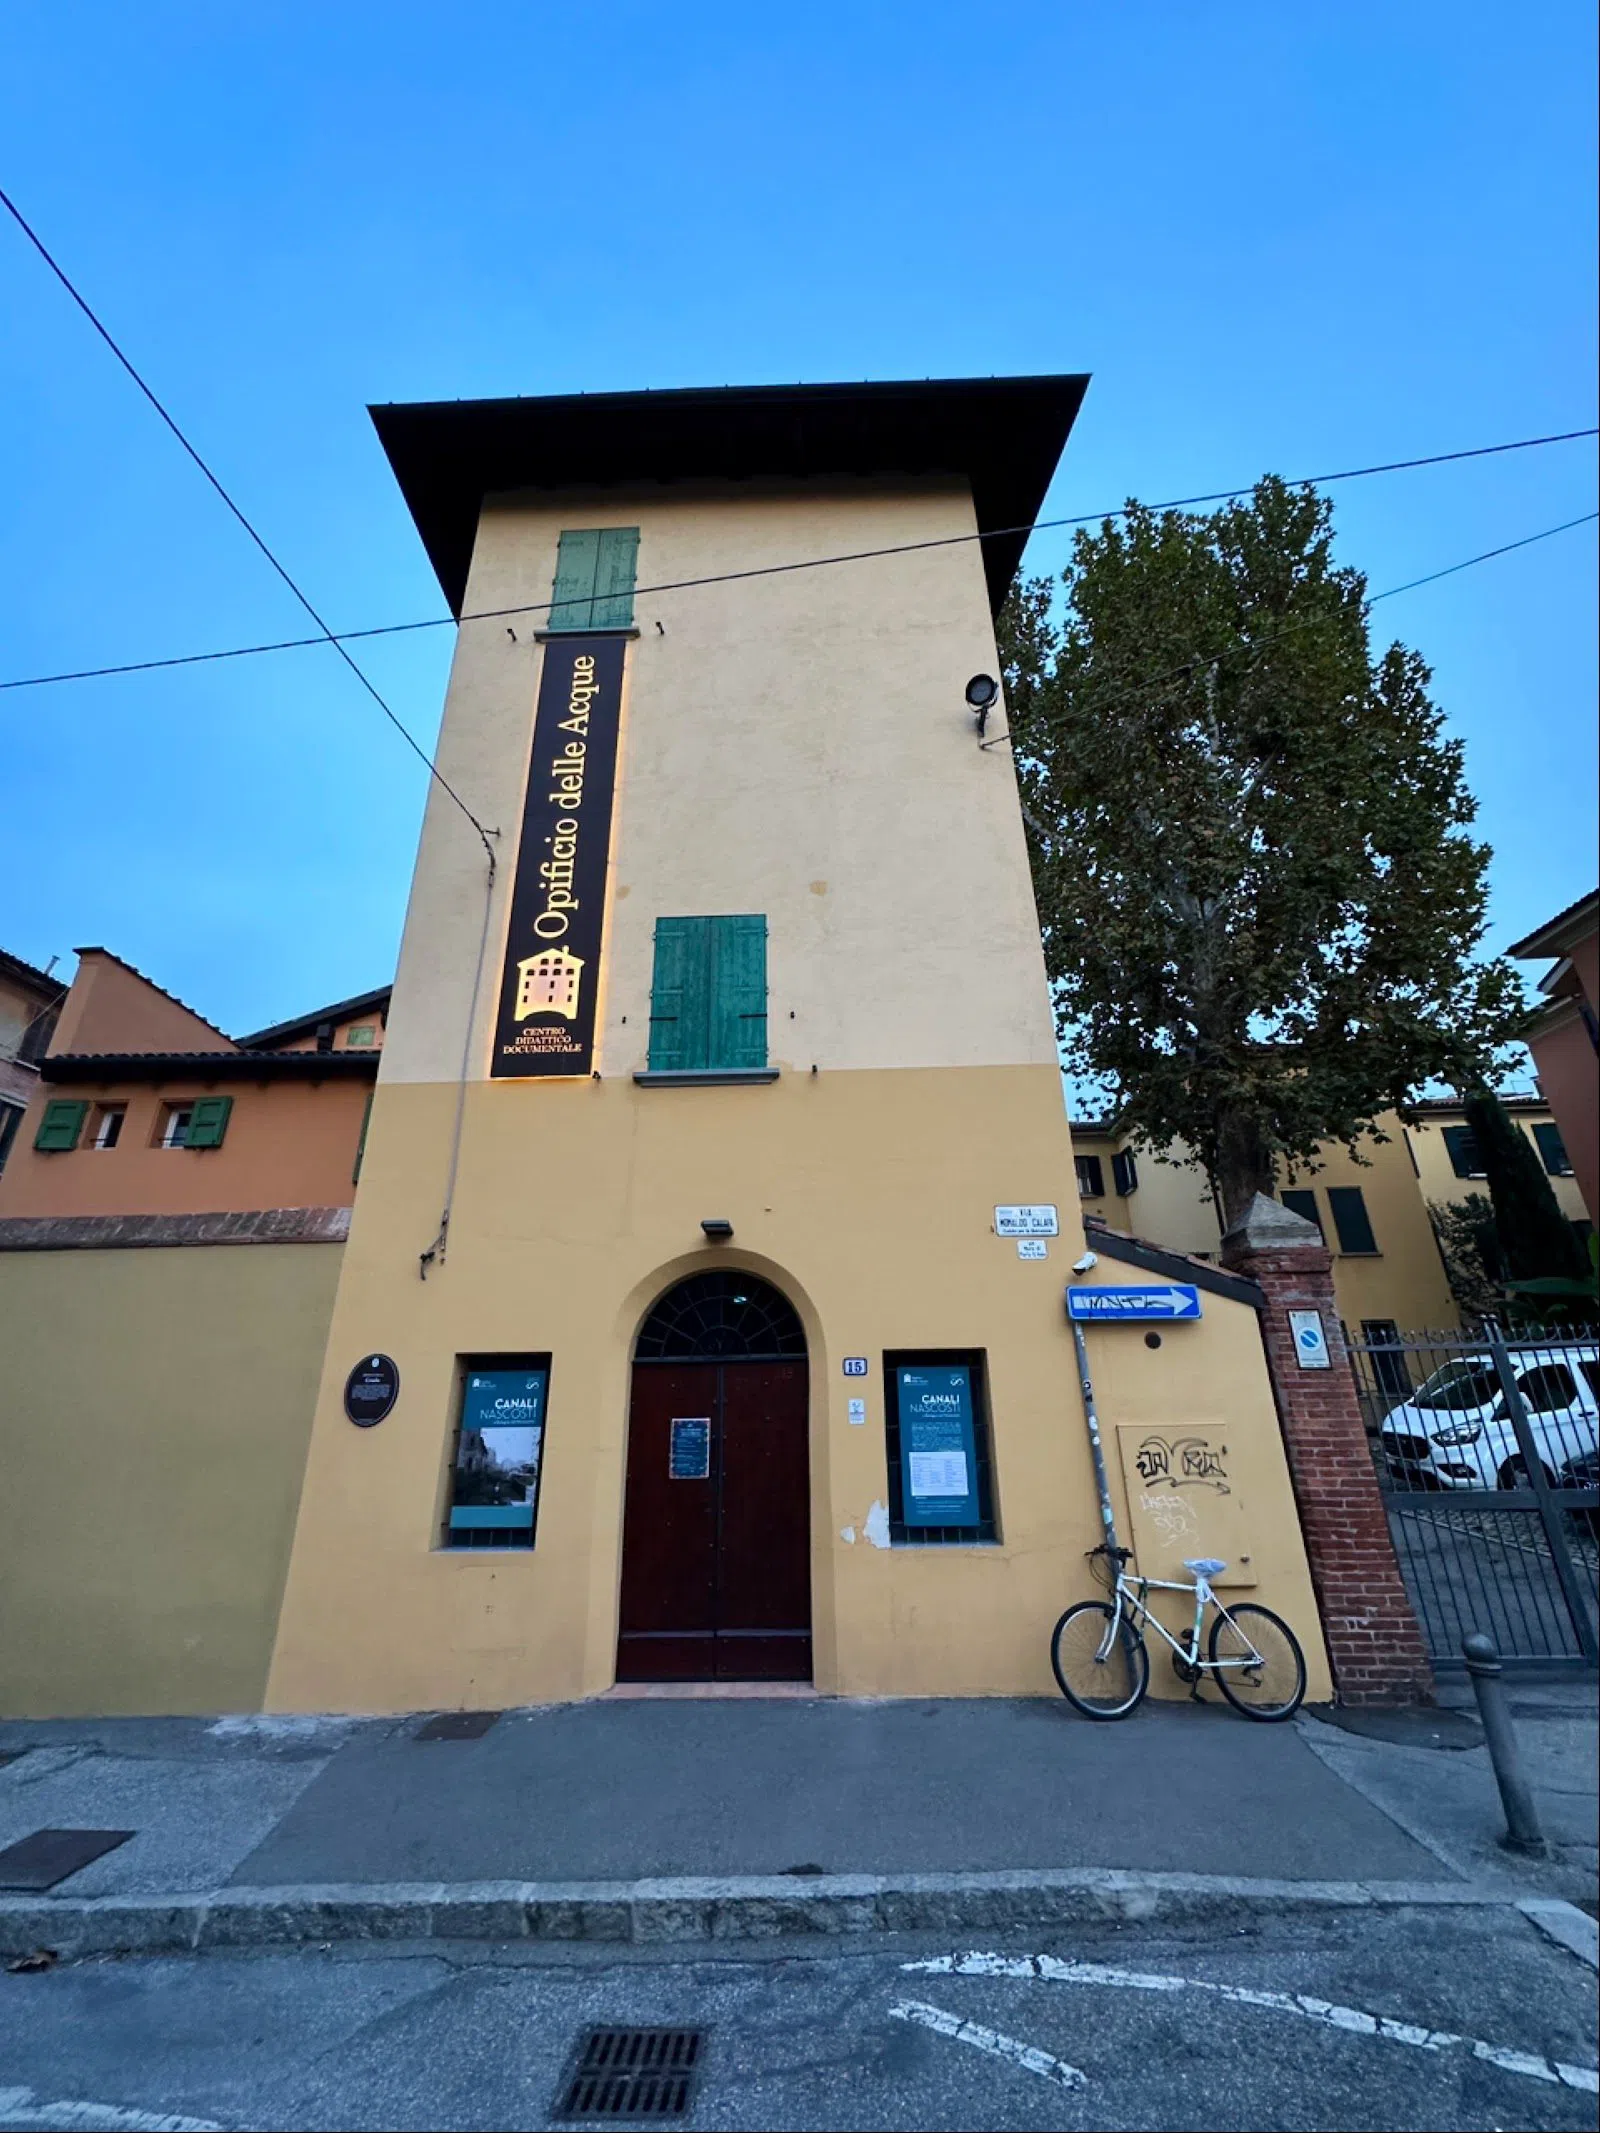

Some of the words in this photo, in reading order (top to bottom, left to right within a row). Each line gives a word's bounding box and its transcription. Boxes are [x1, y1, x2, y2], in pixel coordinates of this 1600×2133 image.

[557, 655, 600, 737] Acque
[549, 741, 587, 810] delle
[533, 818, 580, 938] Opificio
[522, 1026, 566, 1036] CENTRO
[515, 1035, 572, 1045] DIDATTICO
[503, 1043, 583, 1055] DOCUMENTALE
[848, 1361, 863, 1373] 15
[495, 1398, 538, 1409] CANALI
[922, 1394, 960, 1404] CANALI
[480, 1408, 537, 1420] NASCOSTI
[910, 1403, 961, 1413] NASCOSTI
